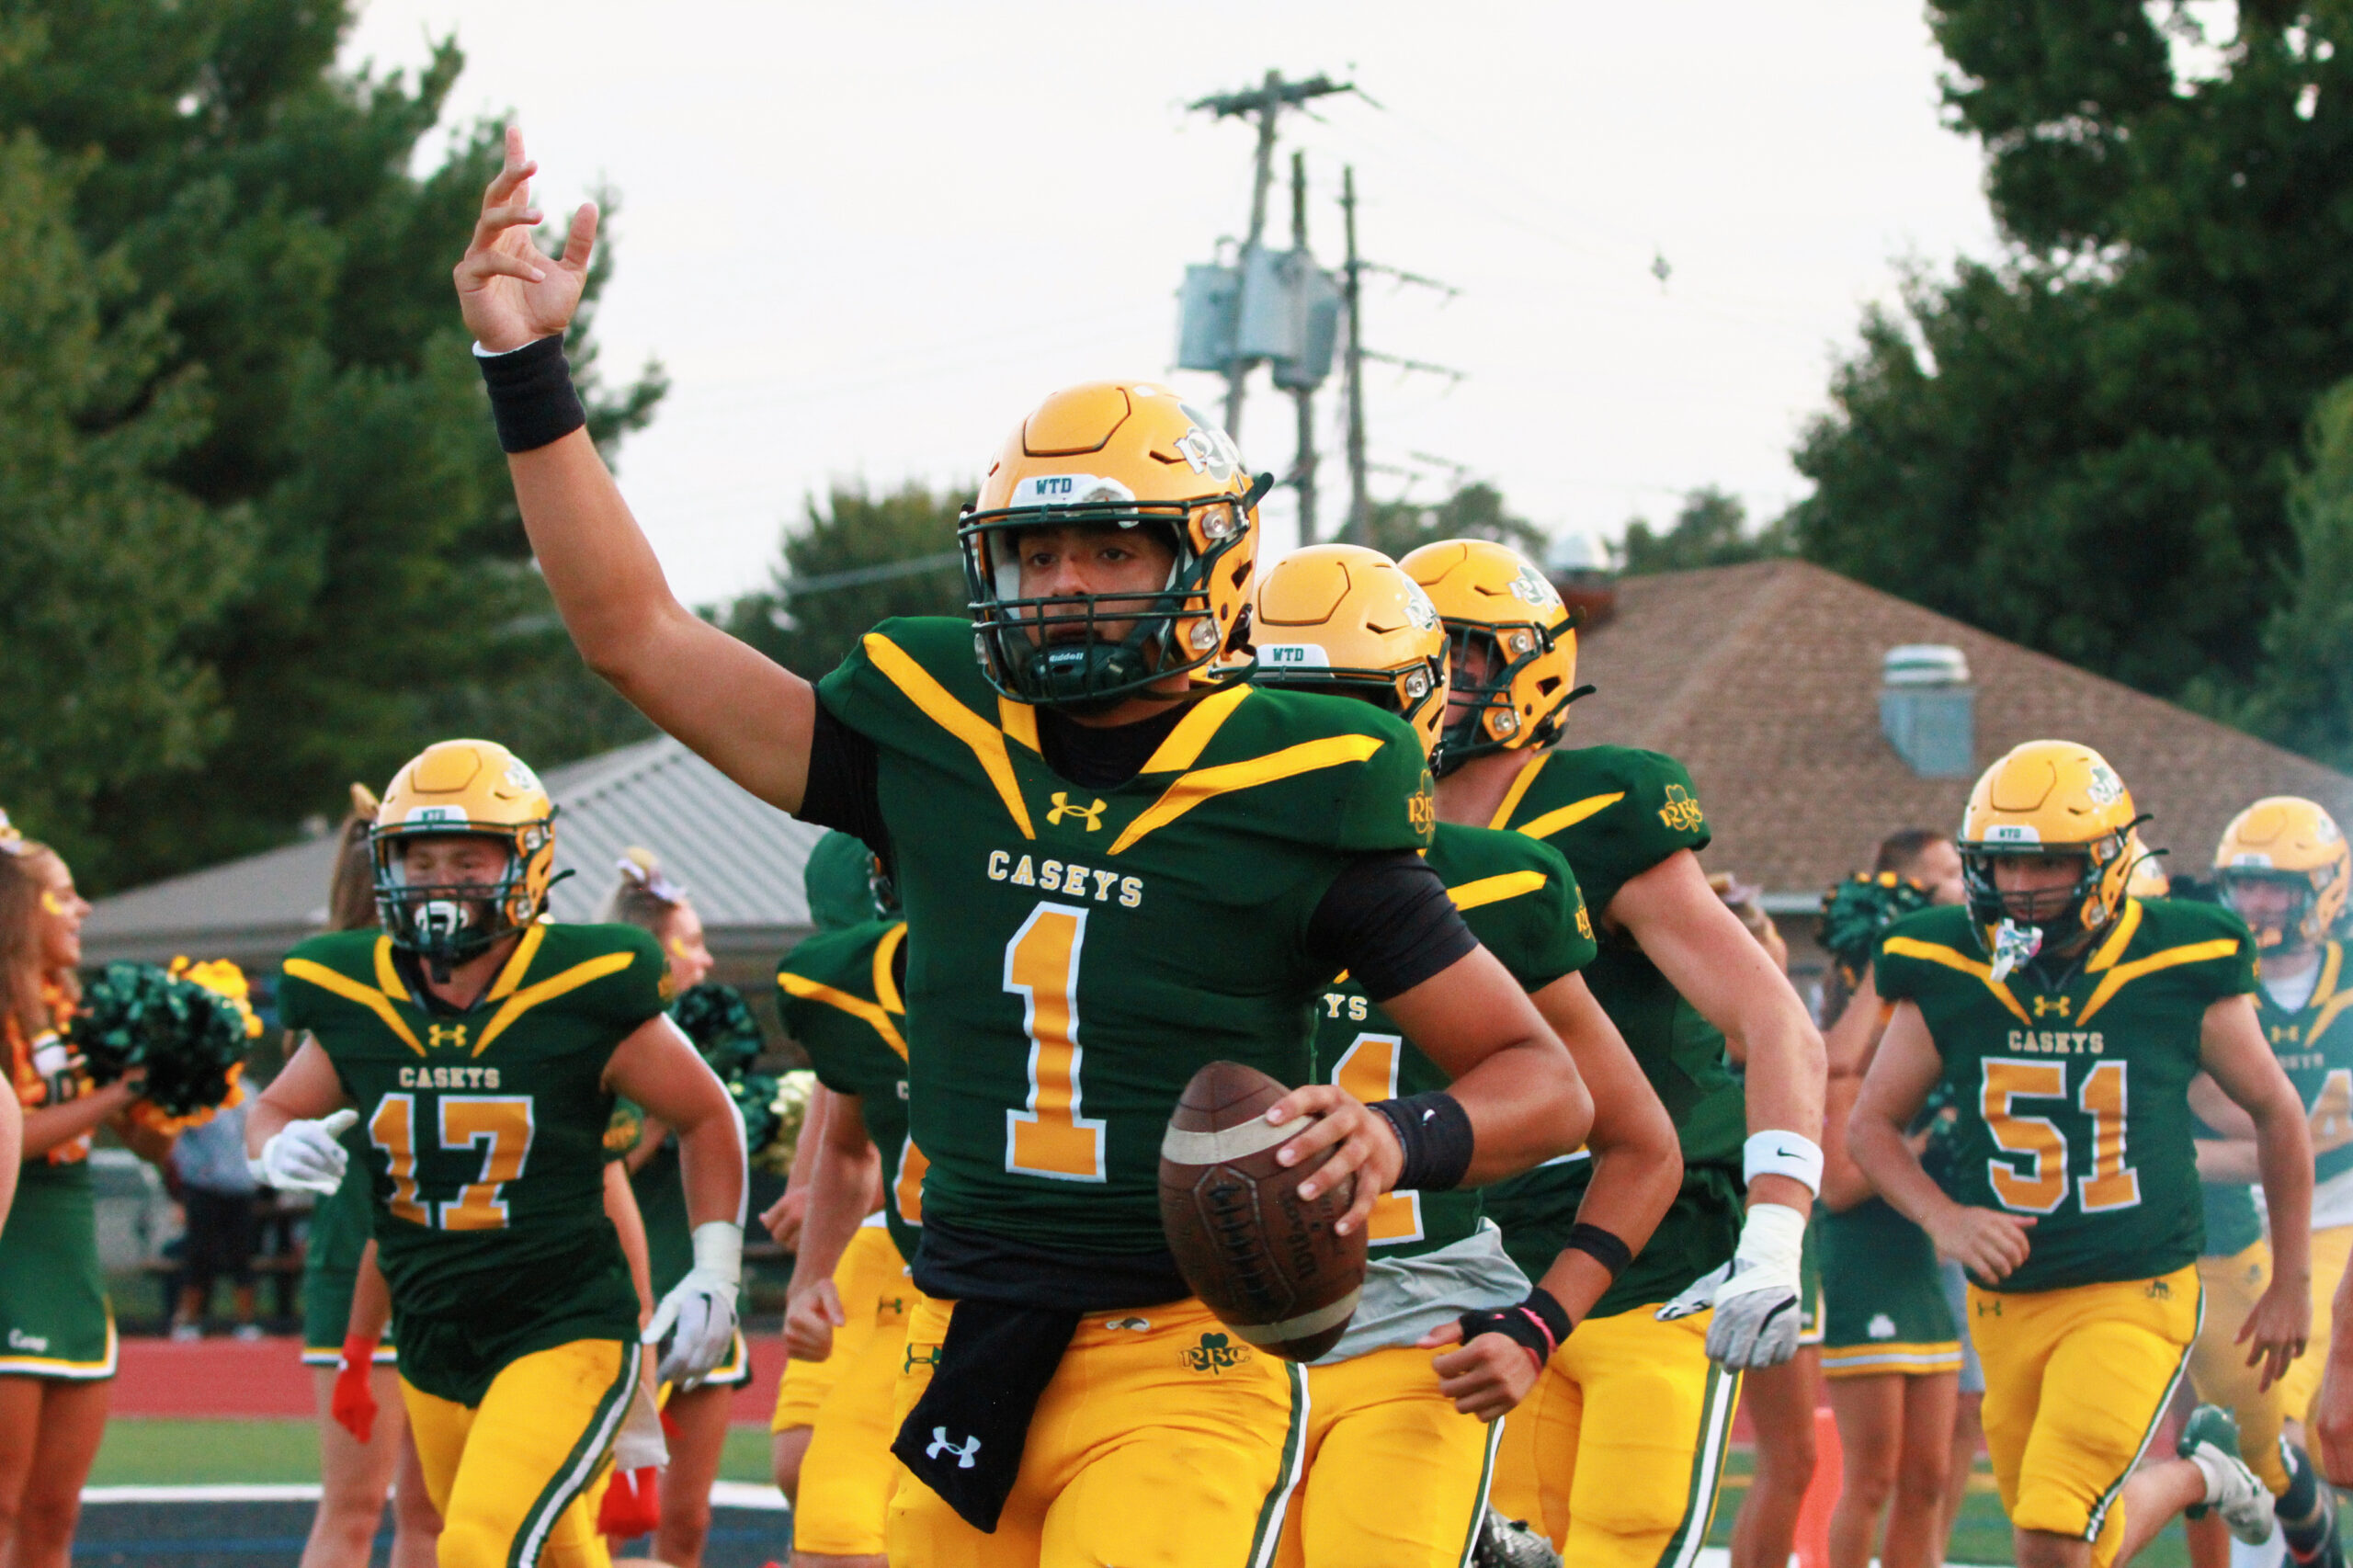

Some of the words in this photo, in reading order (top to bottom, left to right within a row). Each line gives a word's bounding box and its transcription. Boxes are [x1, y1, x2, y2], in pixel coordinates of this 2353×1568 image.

[1036, 478, 1073, 494] WTD
[1273, 648, 1304, 662] WTD
[988, 850, 1143, 907] CASEYS
[1003, 901, 1107, 1183] 1
[2008, 1029, 2104, 1053] CASEYS
[399, 1067, 500, 1088] CASEYS
[1332, 1032, 1425, 1247] 1
[1980, 1056, 2142, 1214] 51
[369, 1092, 535, 1231] 17
[1179, 1346, 1251, 1368] RBC
